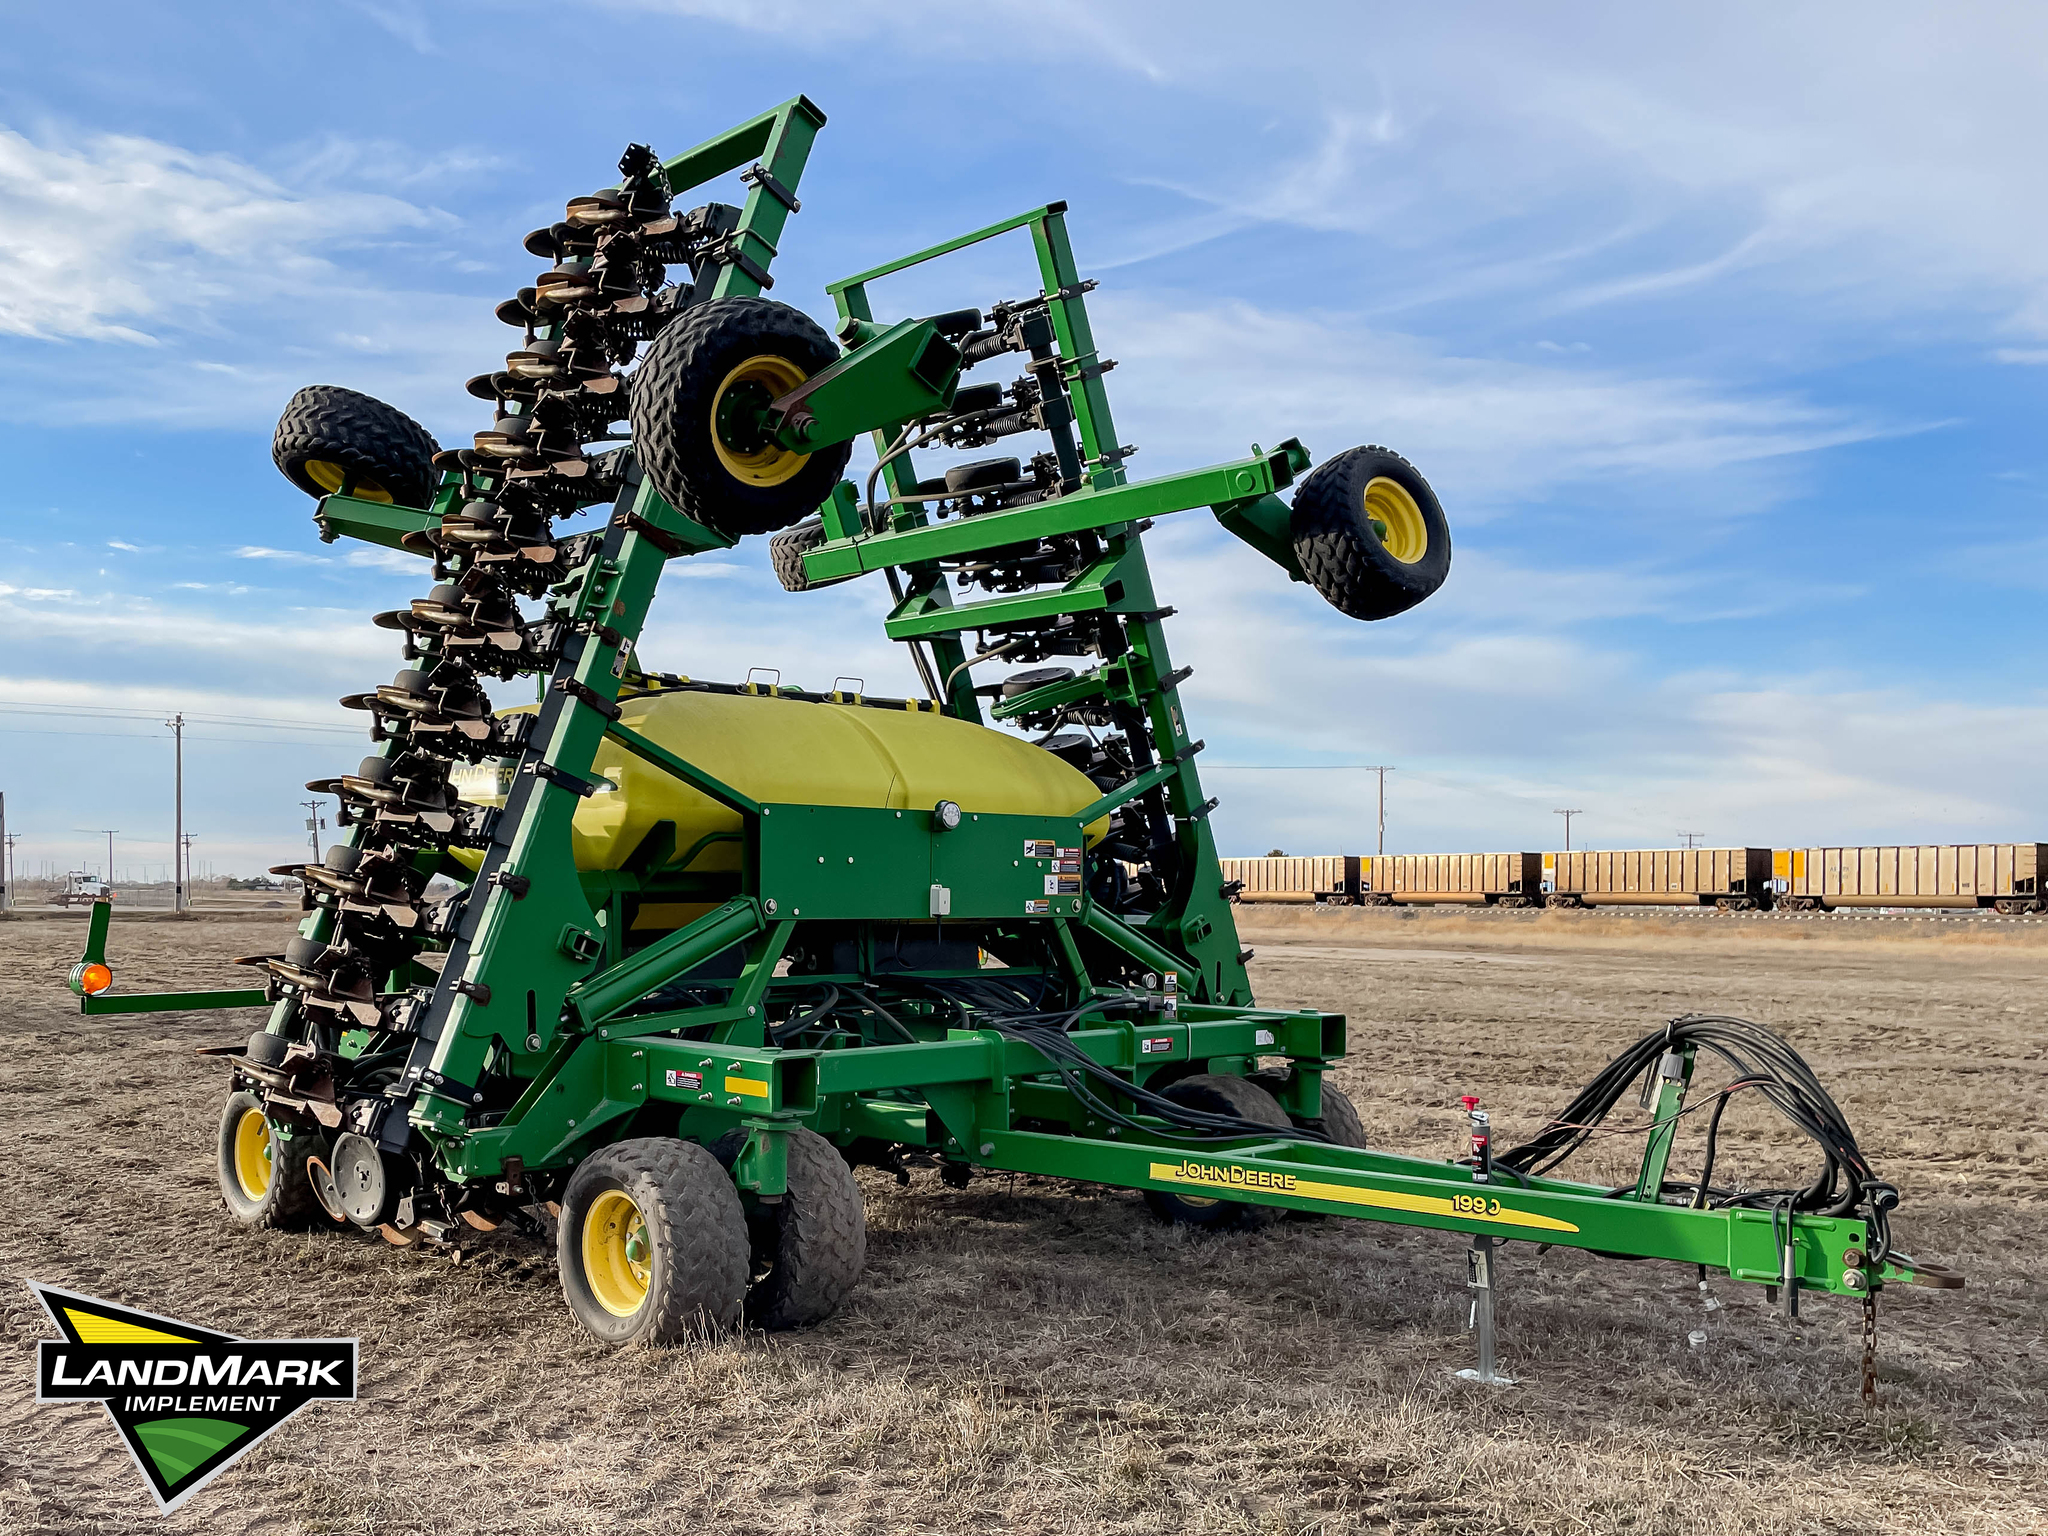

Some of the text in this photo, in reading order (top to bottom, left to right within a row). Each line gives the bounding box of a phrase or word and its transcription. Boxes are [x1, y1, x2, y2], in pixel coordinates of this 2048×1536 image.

[474, 764, 514, 785] DEER
[1176, 1160, 1297, 1190] JOHN DEERE
[1452, 1194, 1501, 1216] 1990
